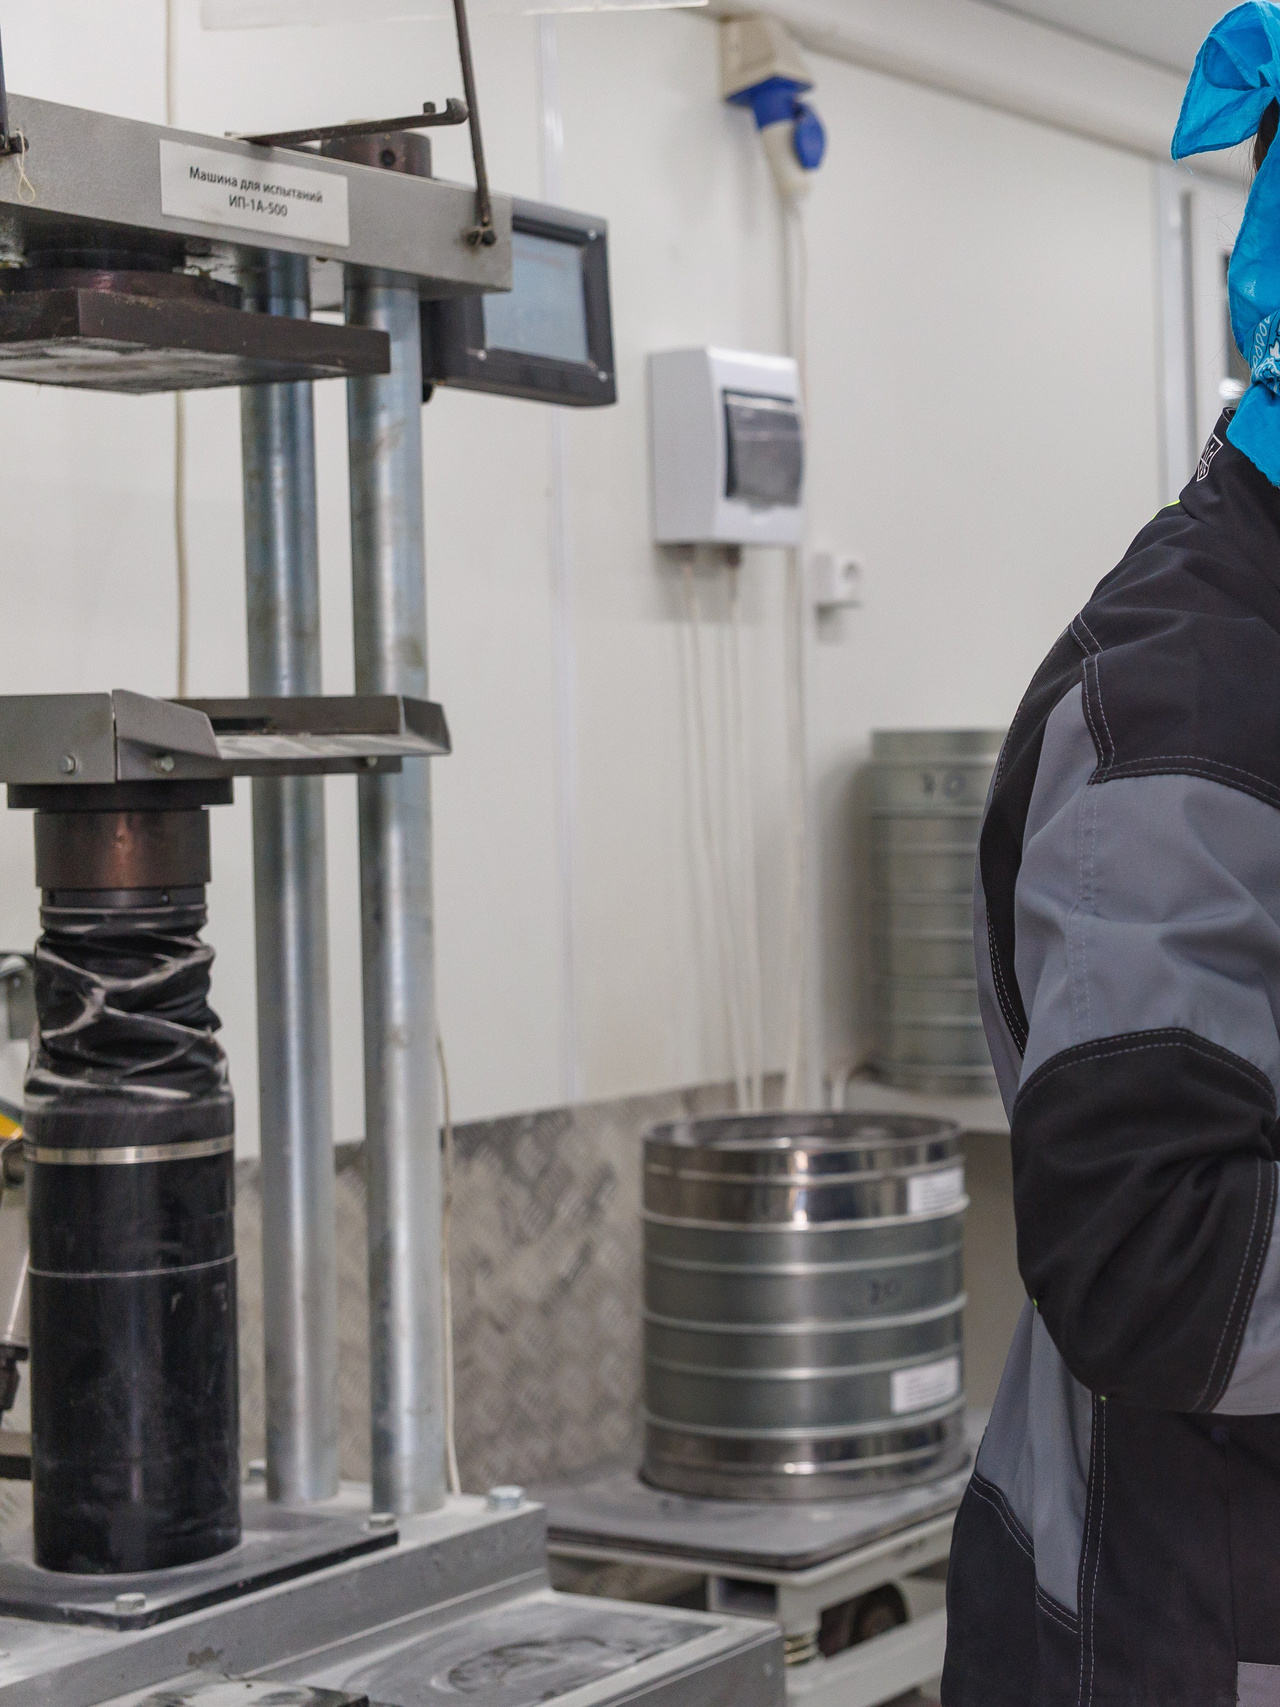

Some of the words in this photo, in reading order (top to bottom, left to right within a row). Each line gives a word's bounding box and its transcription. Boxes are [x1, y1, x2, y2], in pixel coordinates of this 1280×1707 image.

[190, 166, 238, 187] Машина
[240, 179, 261, 191] для
[263, 184, 323, 203] испытаний
[229, 195, 288, 217] ИП-1А-500
